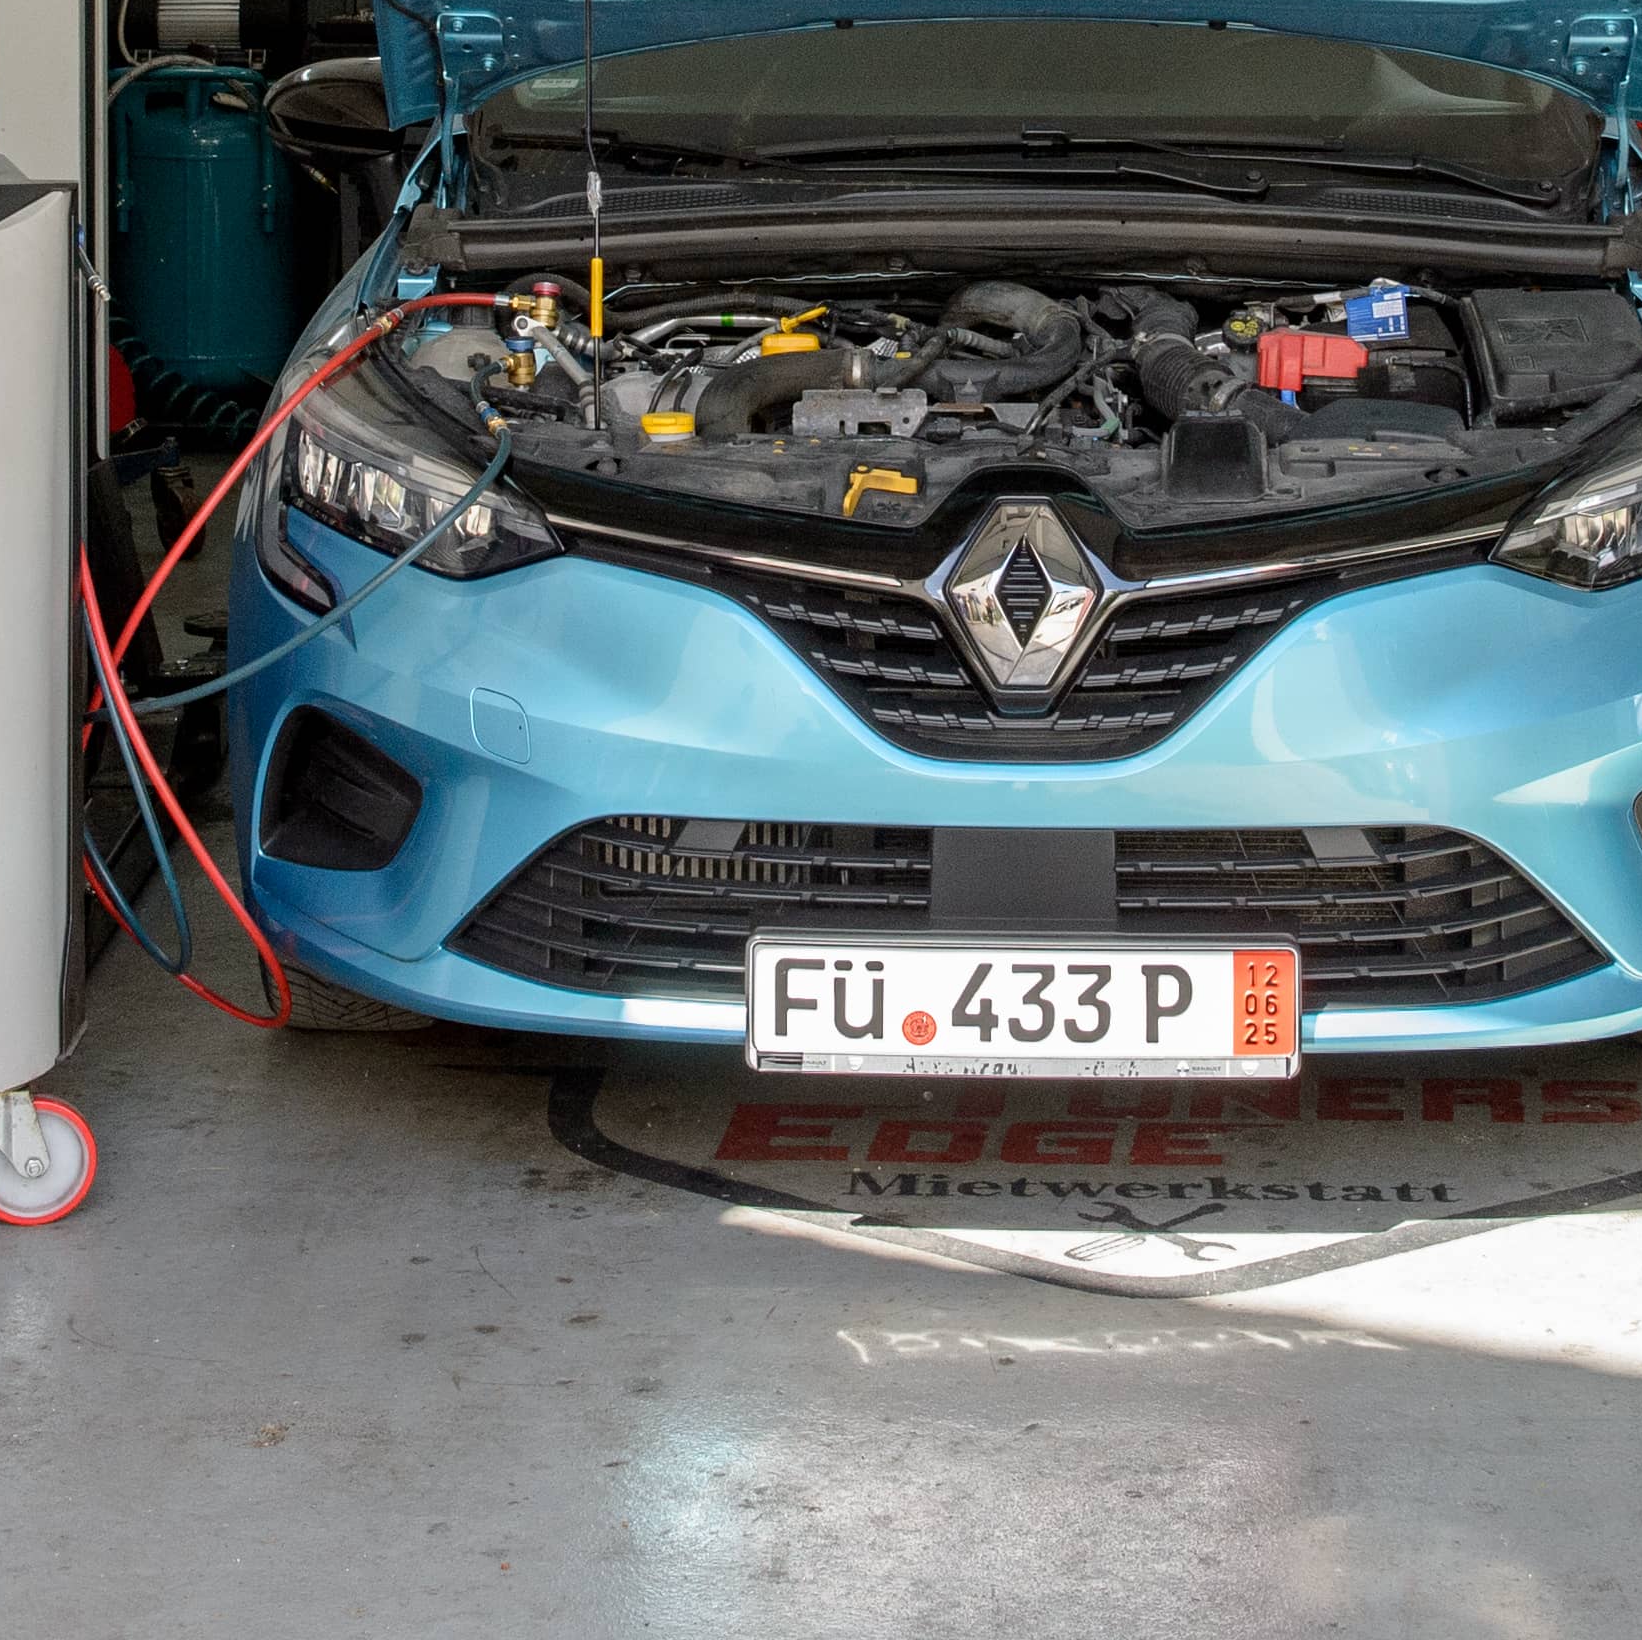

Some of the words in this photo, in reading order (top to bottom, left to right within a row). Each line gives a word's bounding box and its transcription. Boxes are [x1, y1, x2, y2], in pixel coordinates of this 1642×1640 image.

[1247, 962, 1279, 988] 12
[775, 957, 885, 1040] FÜ
[951, 963, 1112, 1044] 433
[1141, 964, 1194, 1044] P
[1244, 993, 1279, 1017] 06
[1244, 1021, 1279, 1045] 25
[715, 1103, 1227, 1167] EDGE
[843, 1166, 1461, 1206] Mietwerkstatt
